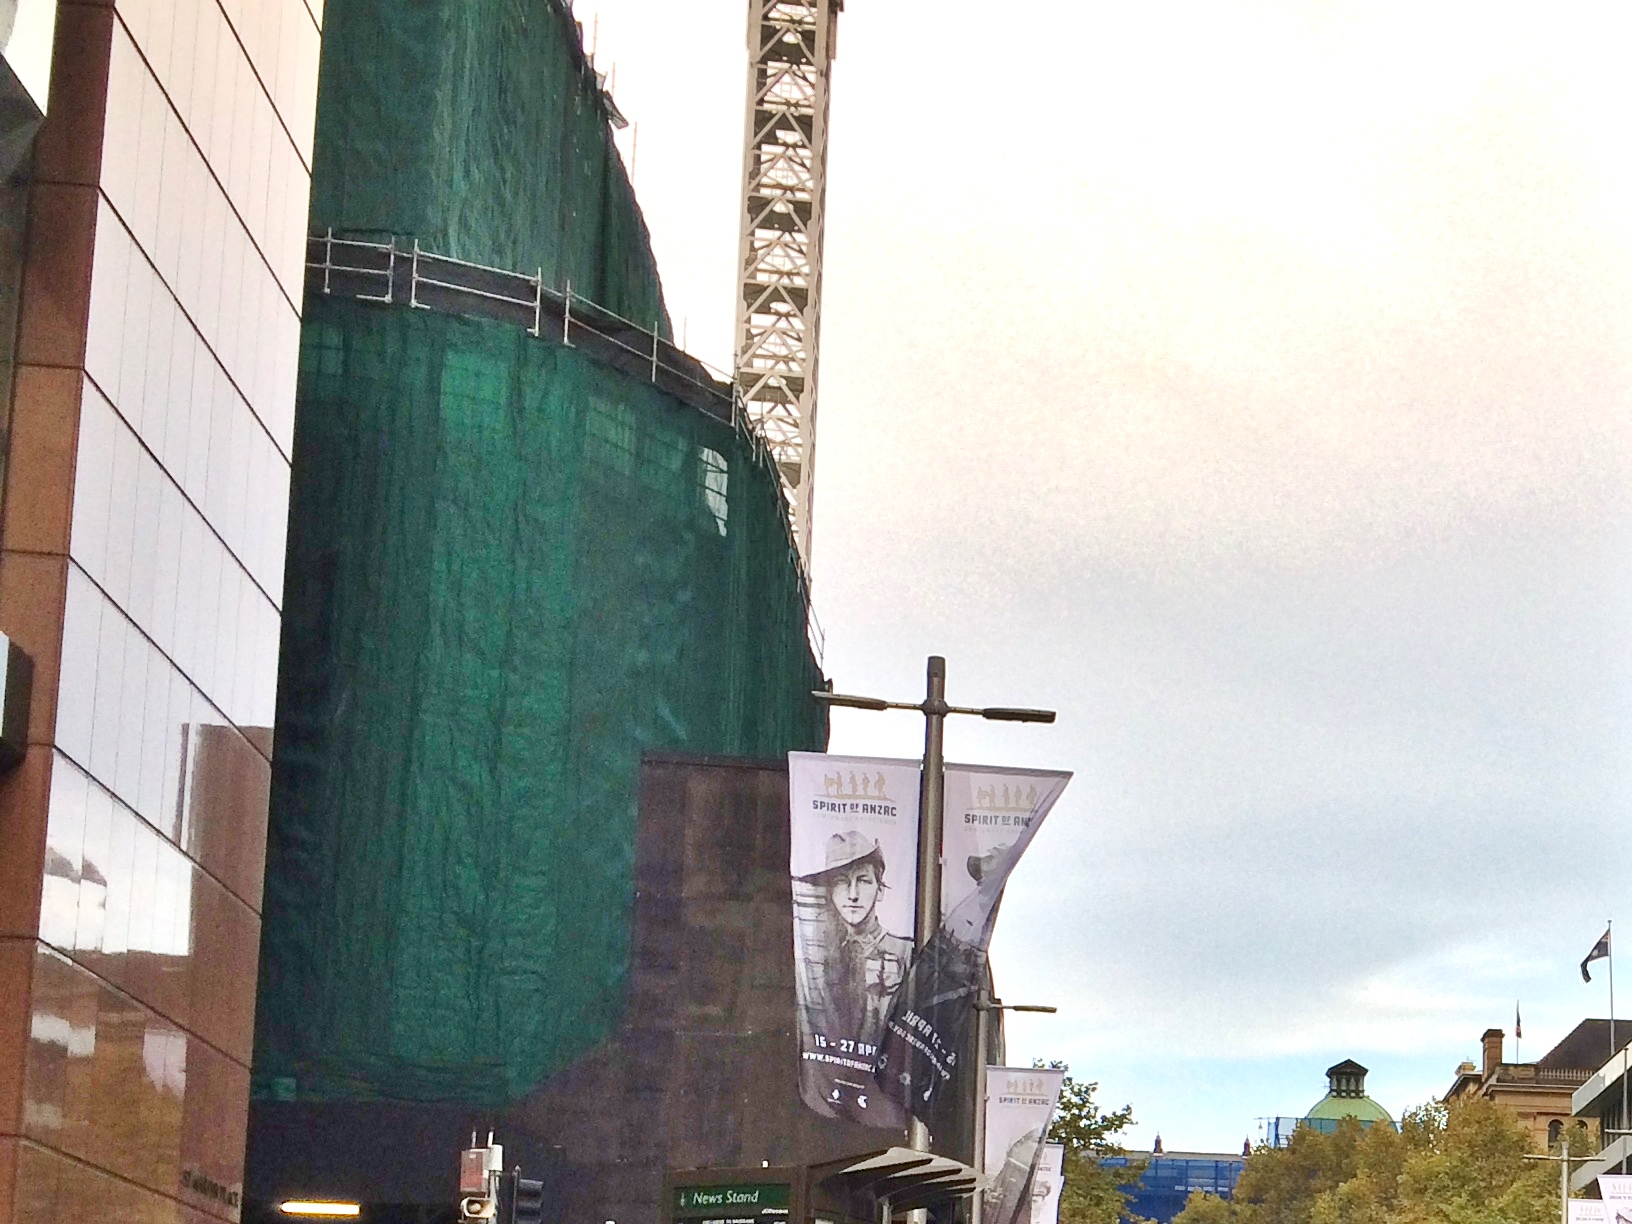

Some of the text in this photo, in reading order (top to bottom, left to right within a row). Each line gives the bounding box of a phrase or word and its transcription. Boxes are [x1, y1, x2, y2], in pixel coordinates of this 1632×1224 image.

[812, 799, 897, 817] SPIRIT OF ANZAC
[964, 813, 1000, 826] SPIRIT
[1001, 815, 1011, 826] OF
[814, 1034, 827, 1048] 15
[840, 1039, 854, 1052] 27
[693, 1190, 759, 1205] News Stand
